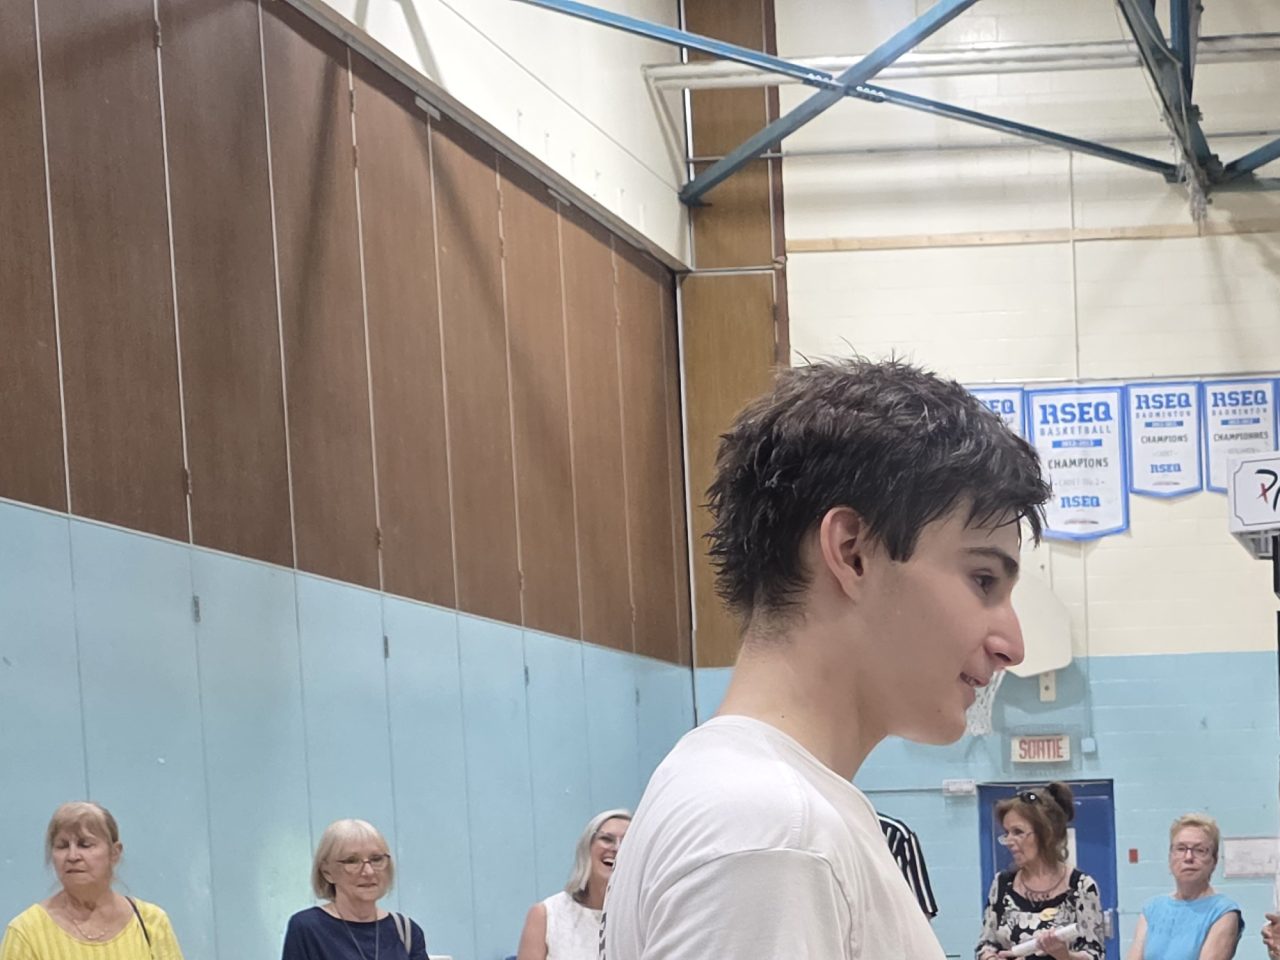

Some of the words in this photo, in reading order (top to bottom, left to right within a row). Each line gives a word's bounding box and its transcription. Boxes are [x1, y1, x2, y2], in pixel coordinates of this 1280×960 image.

[1135, 392, 1192, 410] RSEQ
[1211, 390, 1268, 407] RSEQ
[1039, 401, 1113, 425] RSEQ
[1136, 410, 1191, 419] BADMINTON
[1212, 407, 1267, 417] BADMINTON
[1040, 425, 1111, 436] BASKETBALL
[1213, 431, 1269, 442] CHAMPIONNES
[1141, 434, 1188, 444] CHAMPIONS
[1048, 457, 1108, 470] CHAMPIONS
[1150, 463, 1182, 474] RSEQ
[1061, 495, 1100, 508] RSEQ
[1018, 738, 1064, 760] SORTIE
